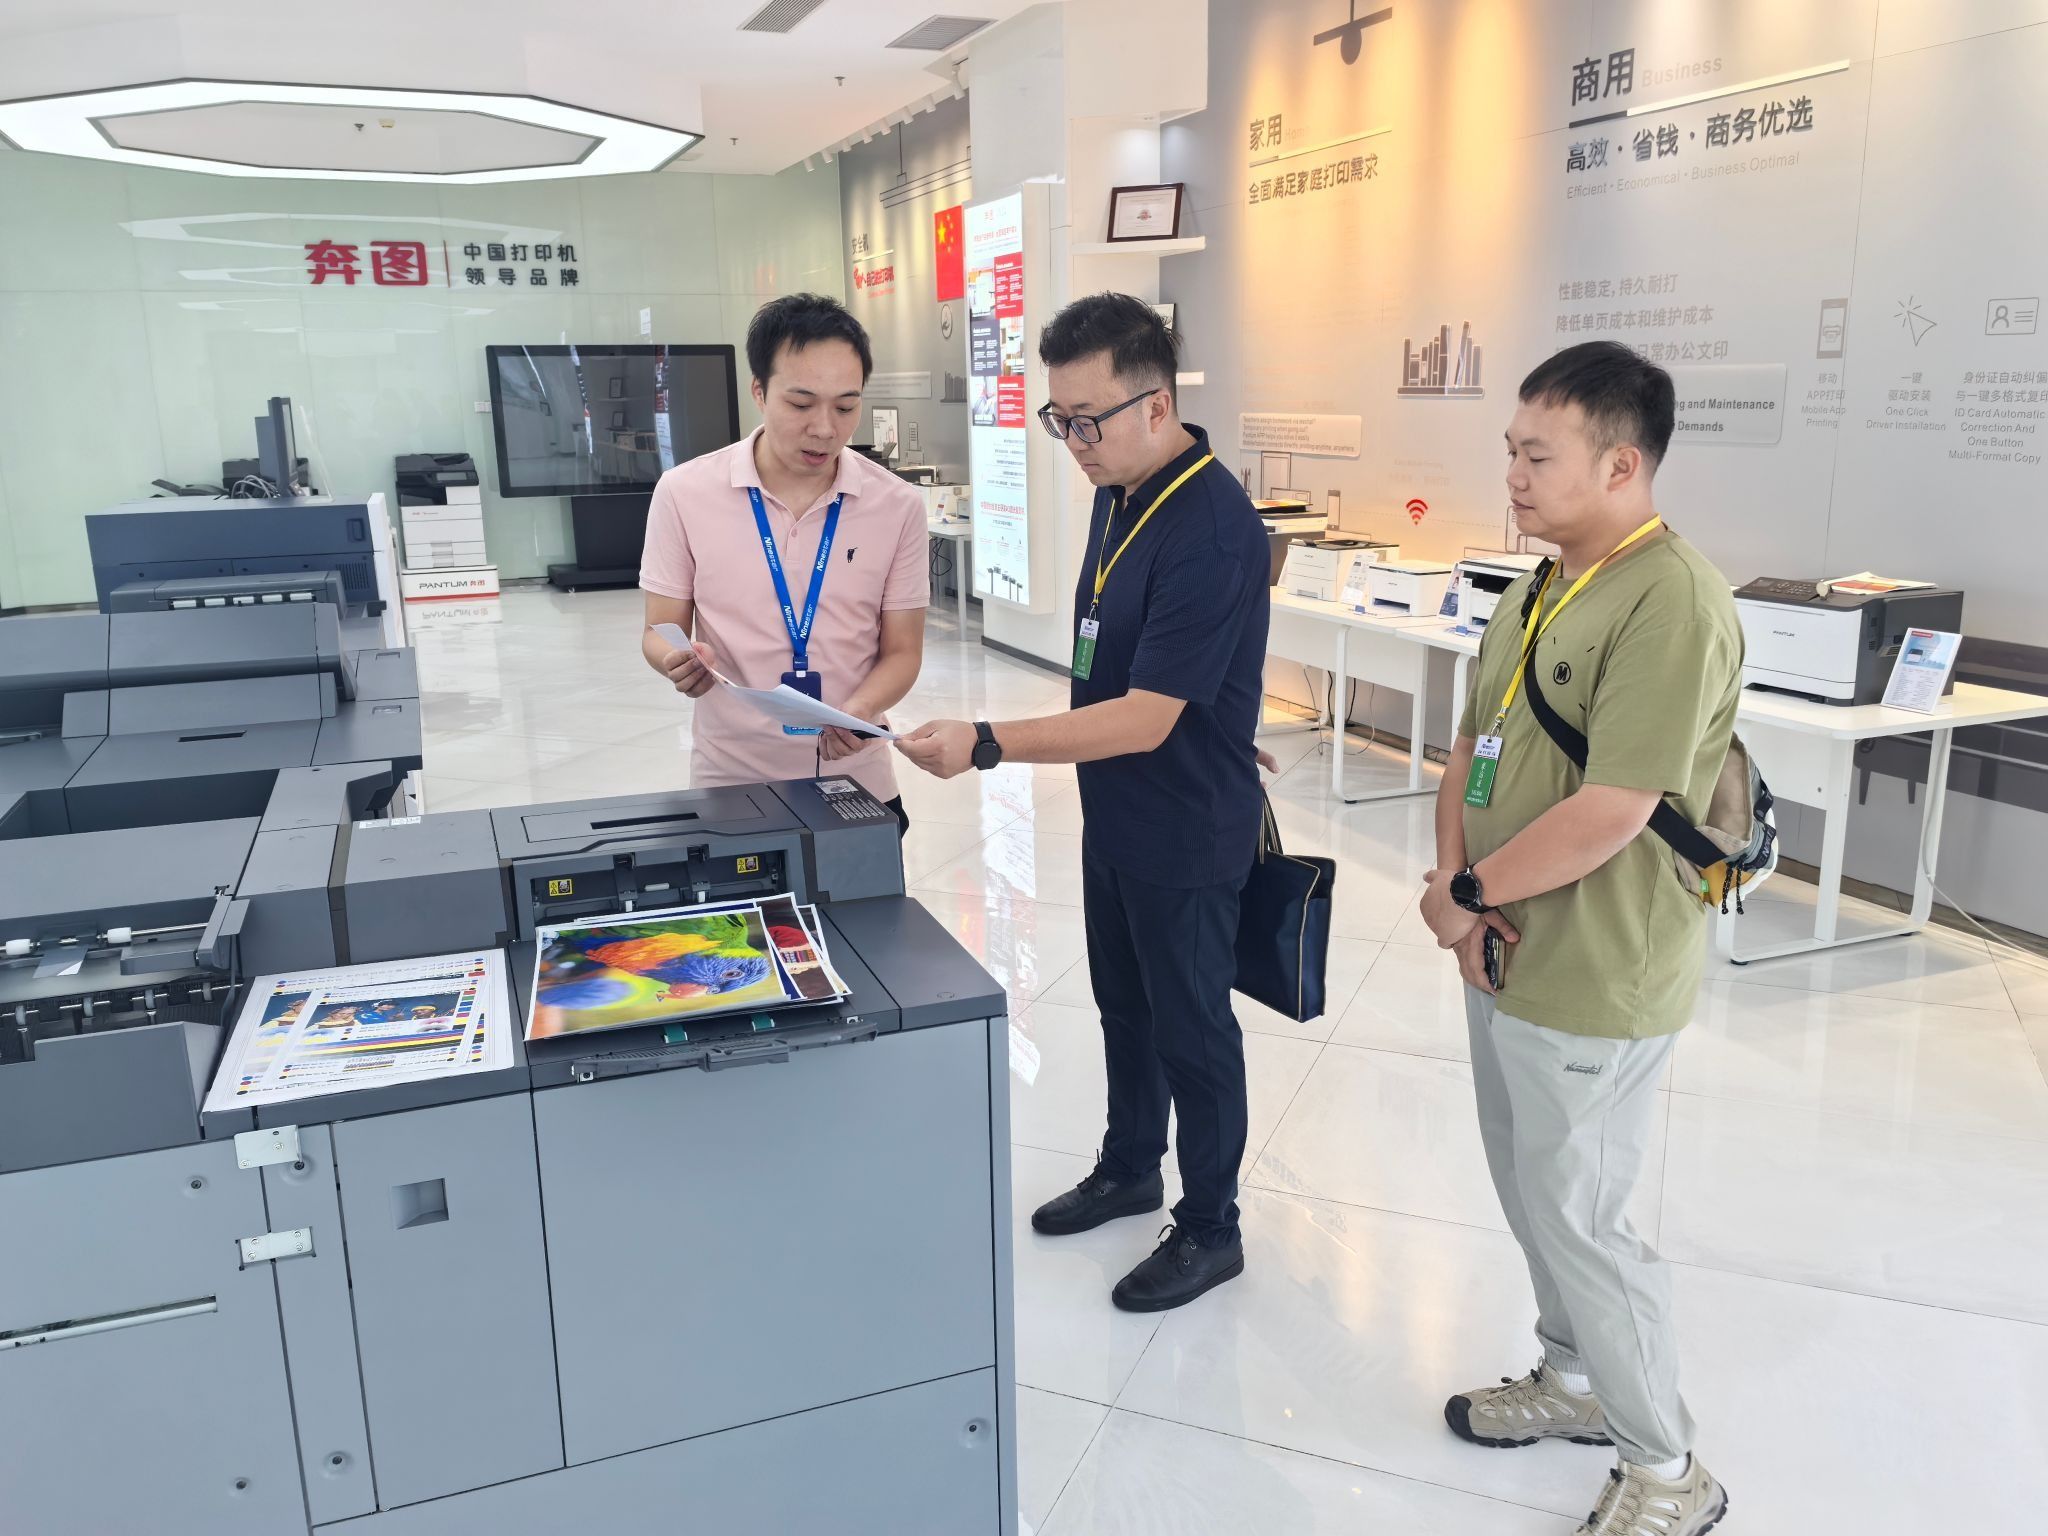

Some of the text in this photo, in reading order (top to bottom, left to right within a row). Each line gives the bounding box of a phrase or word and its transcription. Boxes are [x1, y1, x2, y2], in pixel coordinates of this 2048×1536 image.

[1571, 48, 1635, 106] 商用
[1641, 55, 1723, 88] Business
[1249, 113, 1282, 152] 家用
[1249, 153, 1379, 205] 全面满足家庭打印需求
[1567, 152, 1800, 199] Efficient Economical Business Optimal
[464, 242, 578, 262] 中国打印机
[304, 240, 428, 286] 奔图
[465, 268, 580, 287] 领导品牌
[1555, 304, 1715, 333] 降低单页成本和维护成本
[1818, 372, 1838, 385] 移动
[1806, 389, 1846, 401] APP打印
[1887, 389, 1932, 402] 驱动安装
[1688, 398, 1706, 409] and
[1708, 398, 1775, 410] Maintenance
[1801, 405, 1846, 416] Mobile App
[1886, 406, 1929, 417] One Click
[1954, 407, 2046, 419] ID Card Automatic
[1678, 420, 1724, 432] Demands
[1806, 418, 1839, 430] Printing
[1866, 419, 1947, 431] Driver Installation
[1960, 421, 2036, 434] Correction And
[1967, 436, 2024, 448] One Button
[1948, 449, 2042, 465] Multi-Format Copy
[764, 536, 779, 572] Ninestar
[816, 536, 829, 572] Ninestar
[419, 580, 468, 590] PANTUM
[800, 603, 813, 639] Ninestar
